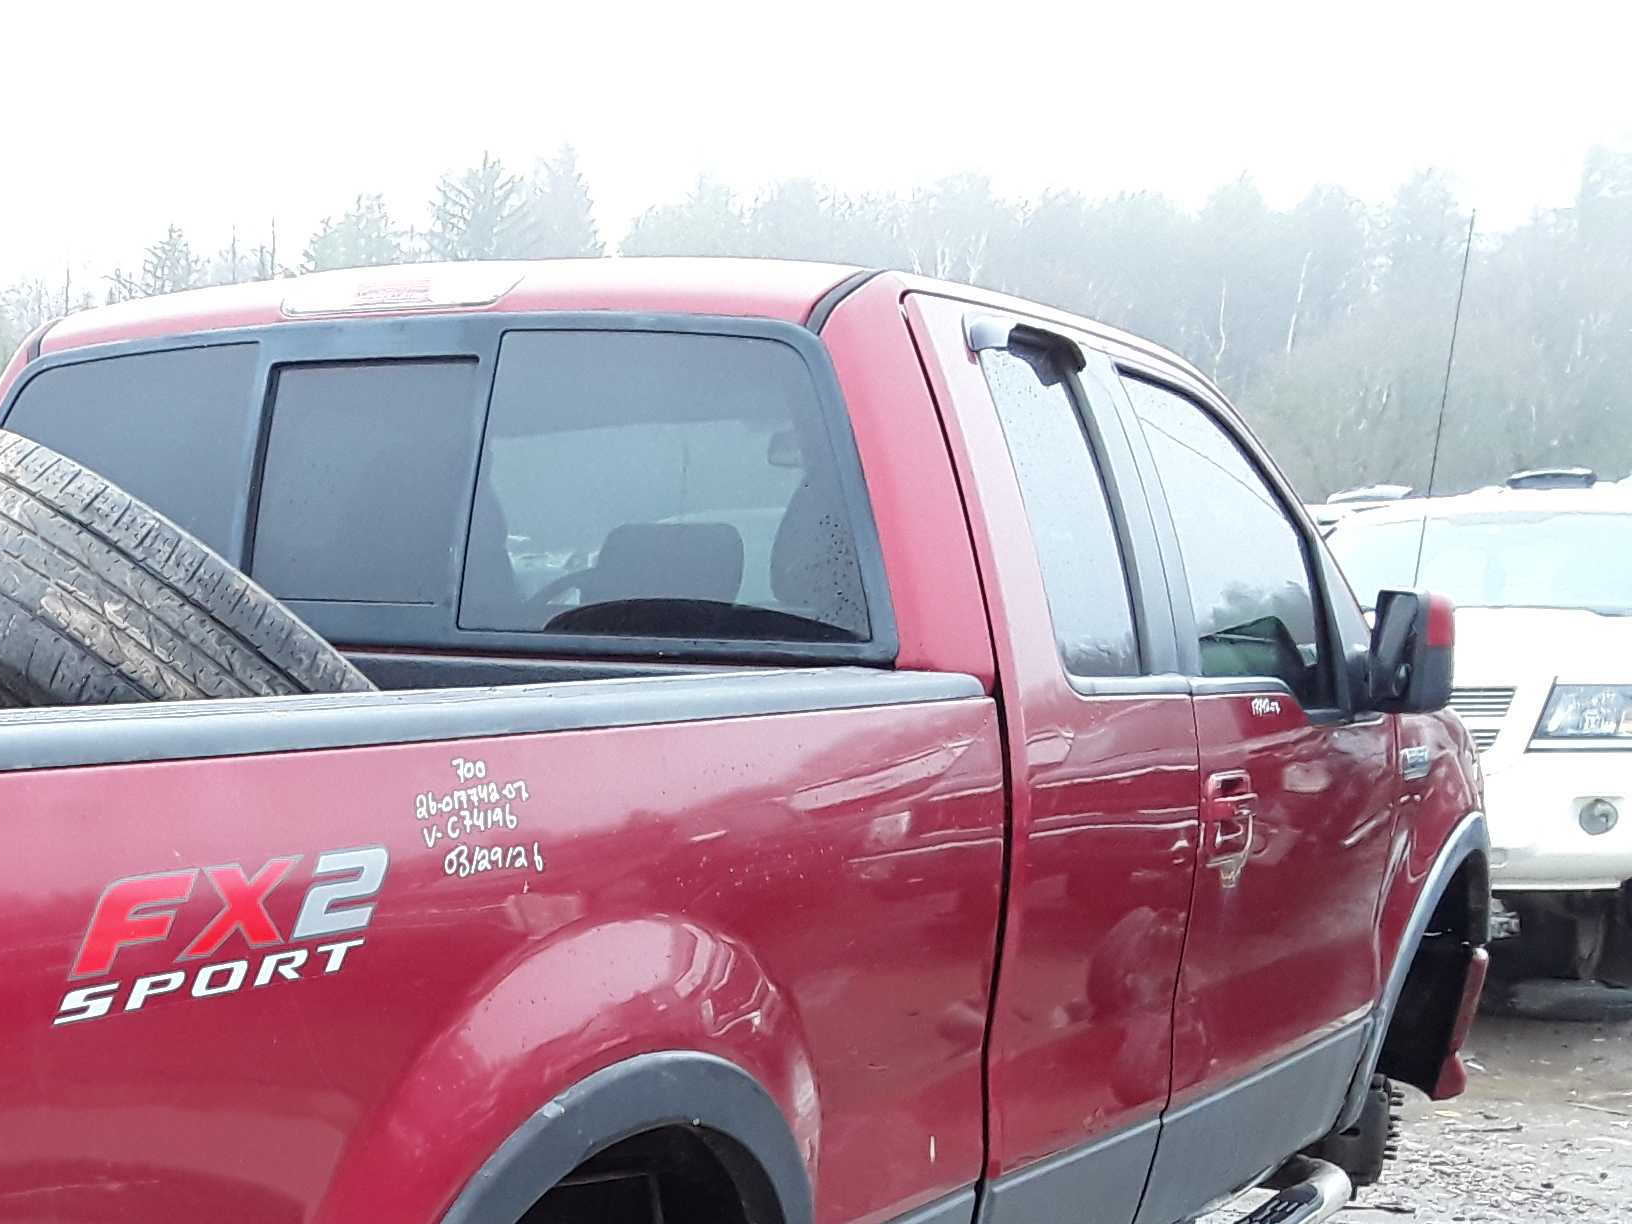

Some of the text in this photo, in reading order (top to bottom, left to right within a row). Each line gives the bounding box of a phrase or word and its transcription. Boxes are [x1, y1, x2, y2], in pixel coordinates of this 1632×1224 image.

[452, 758, 486, 783] 700
[444, 842, 544, 877] 03/29/26
[68, 845, 390, 980] FX2
[52, 937, 366, 1026] SPORT
